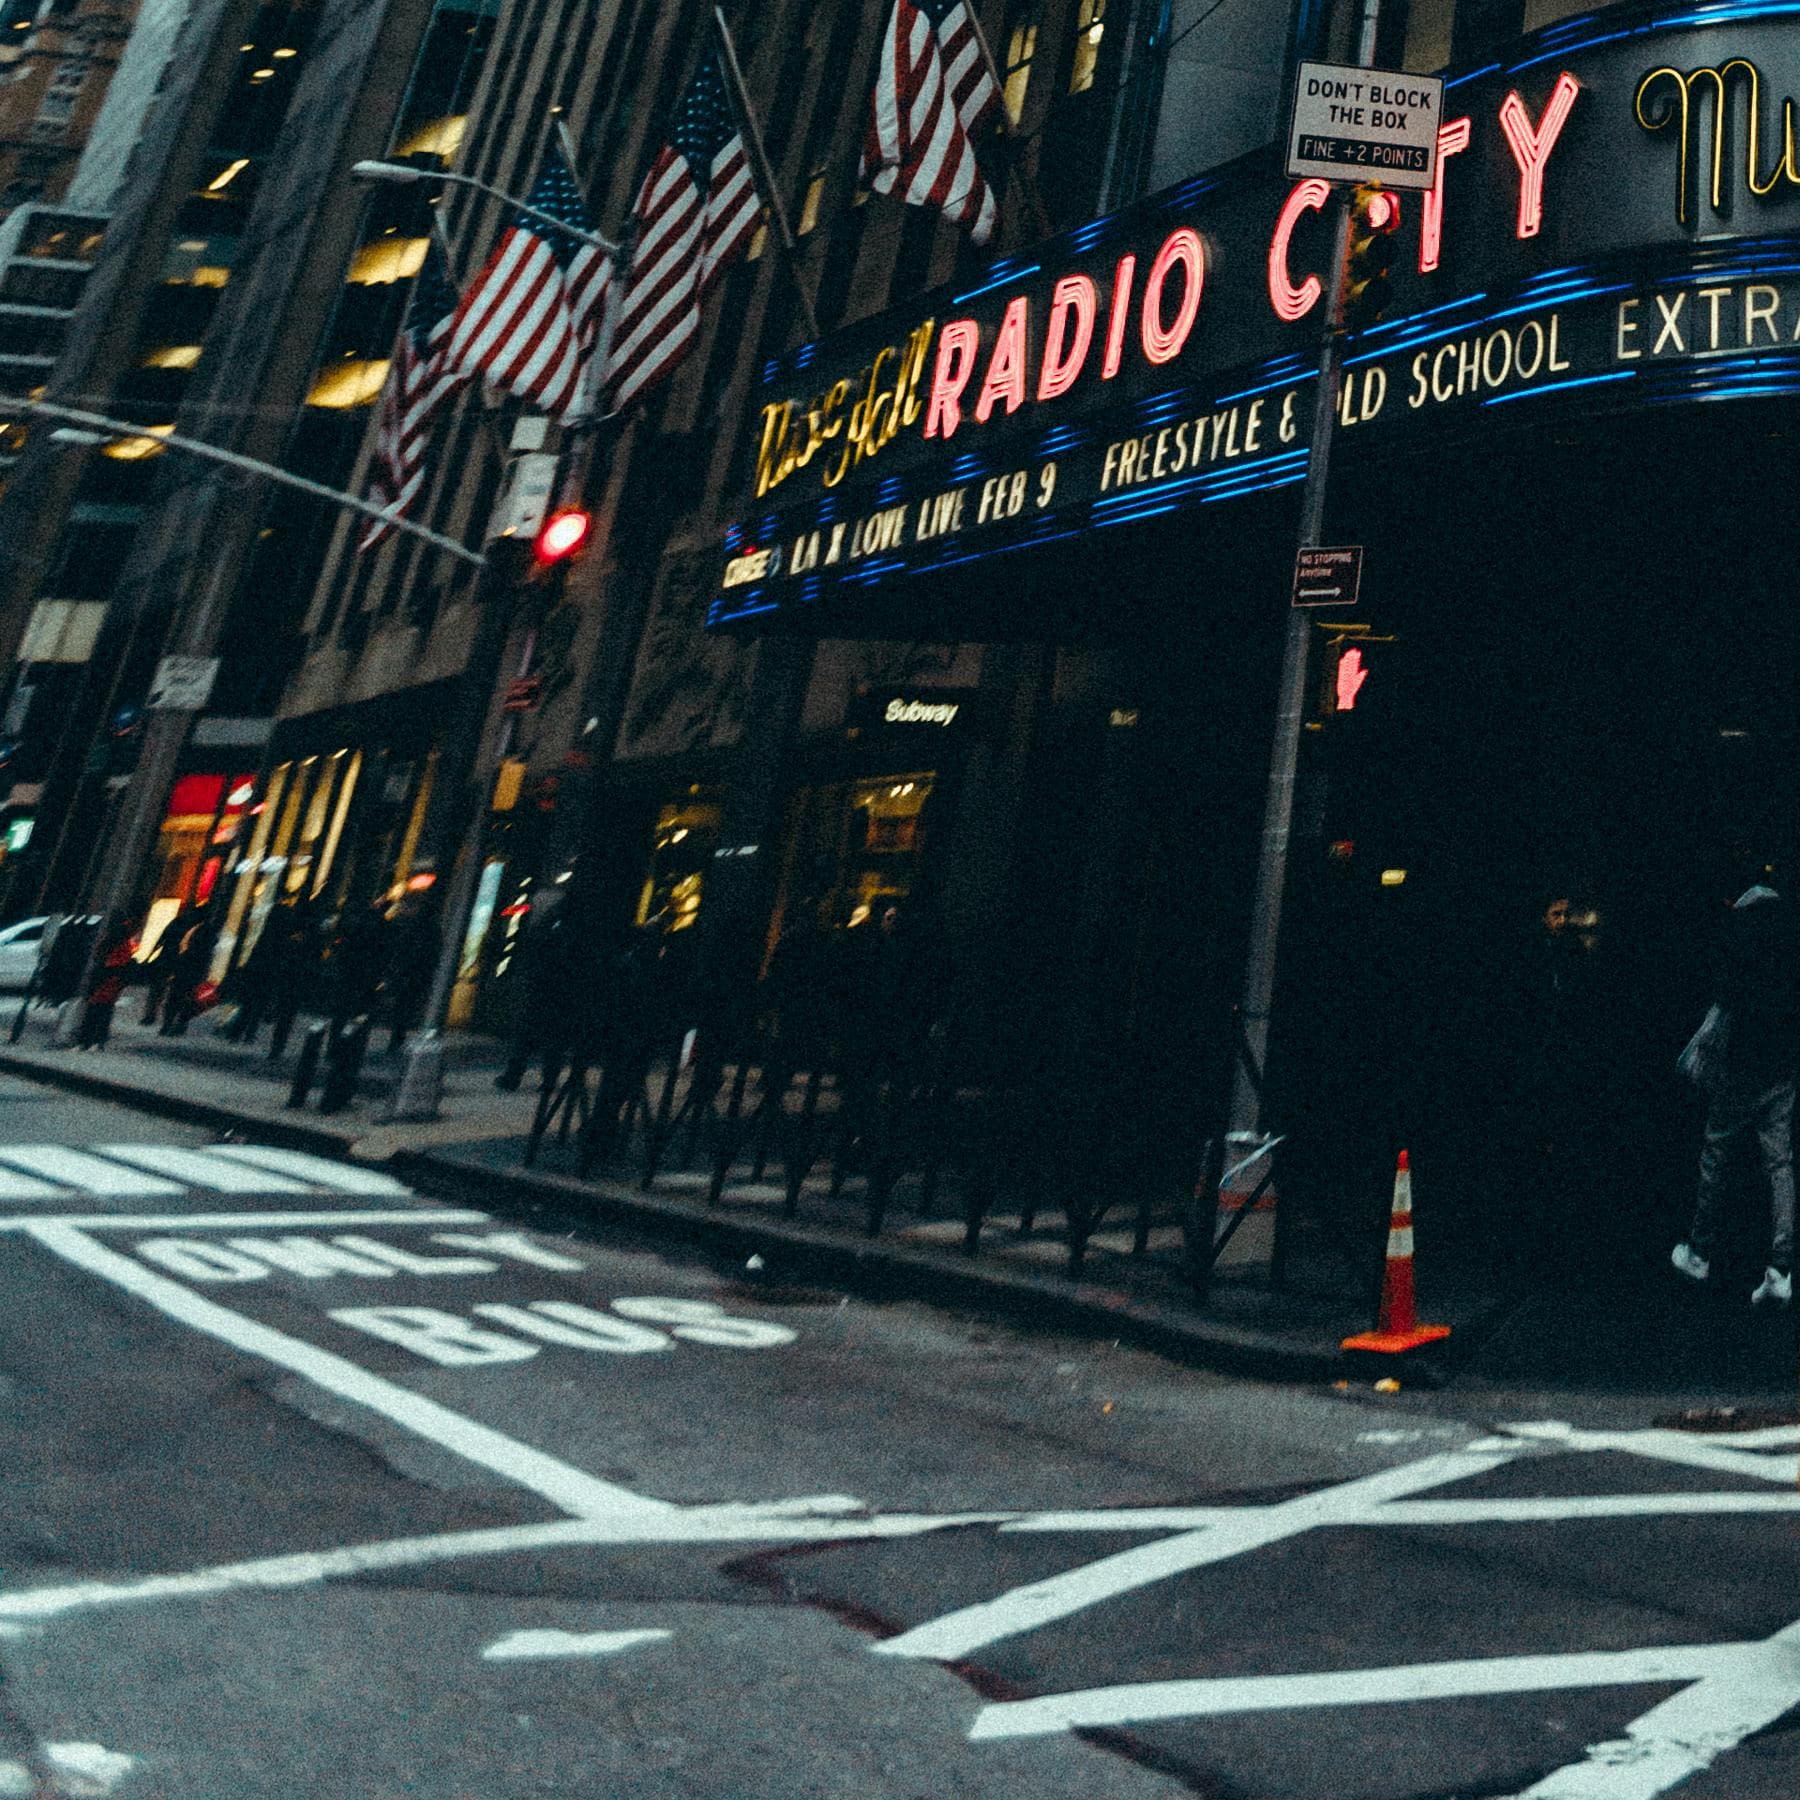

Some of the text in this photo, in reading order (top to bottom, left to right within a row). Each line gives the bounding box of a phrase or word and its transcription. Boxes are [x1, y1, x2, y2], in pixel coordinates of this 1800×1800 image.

[1306, 78, 1432, 110] DON'T BLOCK
[1328, 104, 1408, 131] THE BOX
[1303, 138, 1337, 160] FINE
[1372, 146, 1424, 169] POINTS
[922, 226, 1206, 440] RADIO
[1267, 69, 1580, 322] CTY
[1100, 398, 1265, 491] FREESTYLE
[1279, 390, 1297, 443] &
[1335, 366, 1388, 427] LD
[1407, 313, 1571, 409] SCHOOL
[850, 504, 908, 558] LOVE
[916, 487, 967, 541] LIVE
[977, 470, 1027, 524] FEB
[1036, 461, 1057, 508] 9
[884, 697, 960, 728] Subway
[134, 1231, 588, 1282] ONLY
[325, 1295, 800, 1367] BUS
